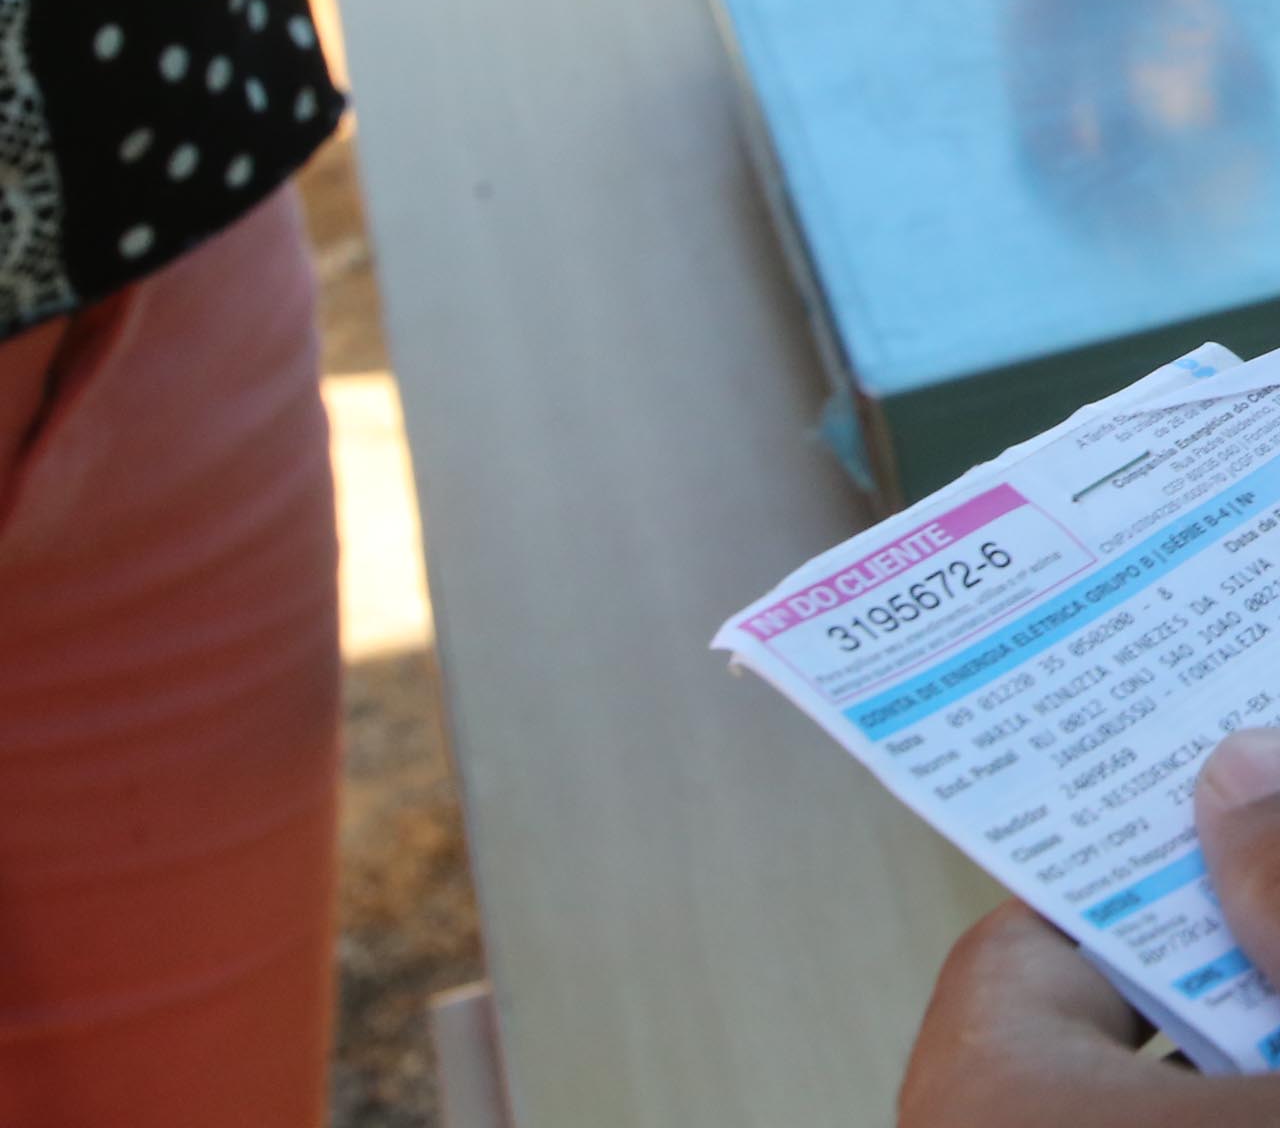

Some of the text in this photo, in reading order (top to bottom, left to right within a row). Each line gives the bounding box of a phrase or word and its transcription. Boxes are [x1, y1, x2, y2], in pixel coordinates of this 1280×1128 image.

[788, 585, 838, 624] DO
[835, 523, 953, 595] CLIENTE
[1222, 529, 1259, 553] Data
[1257, 511, 1278, 533] de
[827, 541, 1011, 651] 3195672-6
[914, 681, 943, 701] DE
[1011, 600, 1086, 647] ELÉTRICA
[1084, 564, 1141, 603] GRUPO
[1138, 555, 1155, 569] B
[1159, 521, 1207, 554] SÉRIE
[1202, 507, 1230, 527] B-4
[1112, 614, 1188, 665] MENEZES
[1188, 595, 1218, 616] DA
[1219, 557, 1272, 595] SILVA
[1158, 643, 1194, 668] SAO
[1197, 610, 1242, 645] JOAO
[1177, 622, 1270, 685] FORTALEZA
